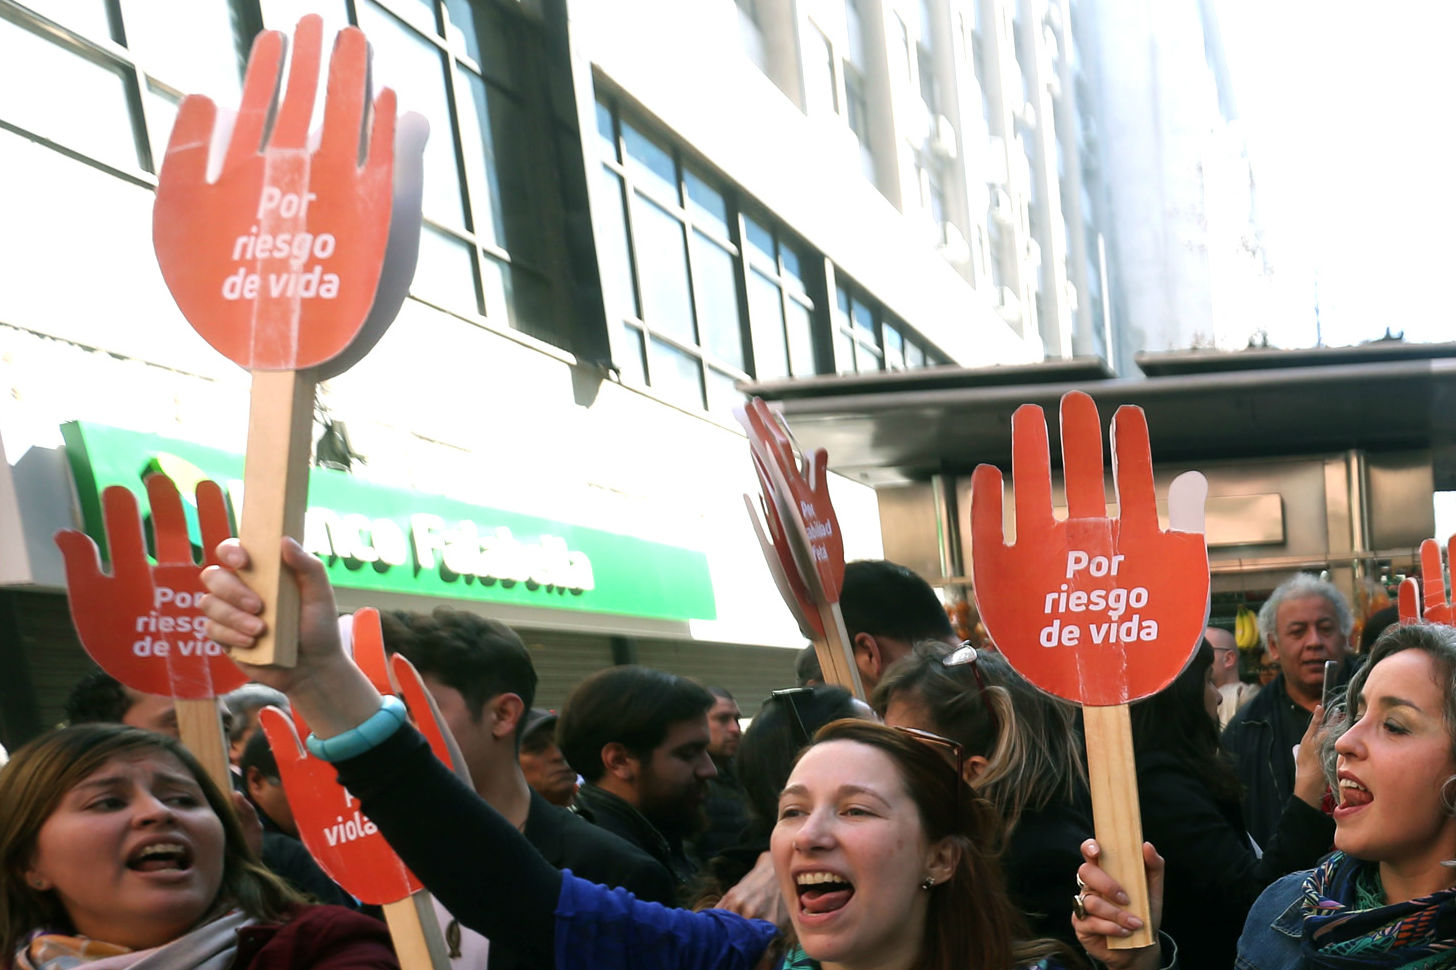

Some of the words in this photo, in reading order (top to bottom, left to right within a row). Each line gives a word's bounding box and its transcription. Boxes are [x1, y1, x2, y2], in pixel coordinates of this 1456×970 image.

[257, 186, 317, 220] Por
[232, 225, 336, 266] riesgo
[222, 267, 261, 300] de
[268, 265, 340, 299] vida
[1066, 550, 1125, 579] Por
[1044, 583, 1149, 617] riesgo
[133, 636, 170, 657] de
[1039, 619, 1080, 648] de
[1089, 614, 1159, 644] vida
